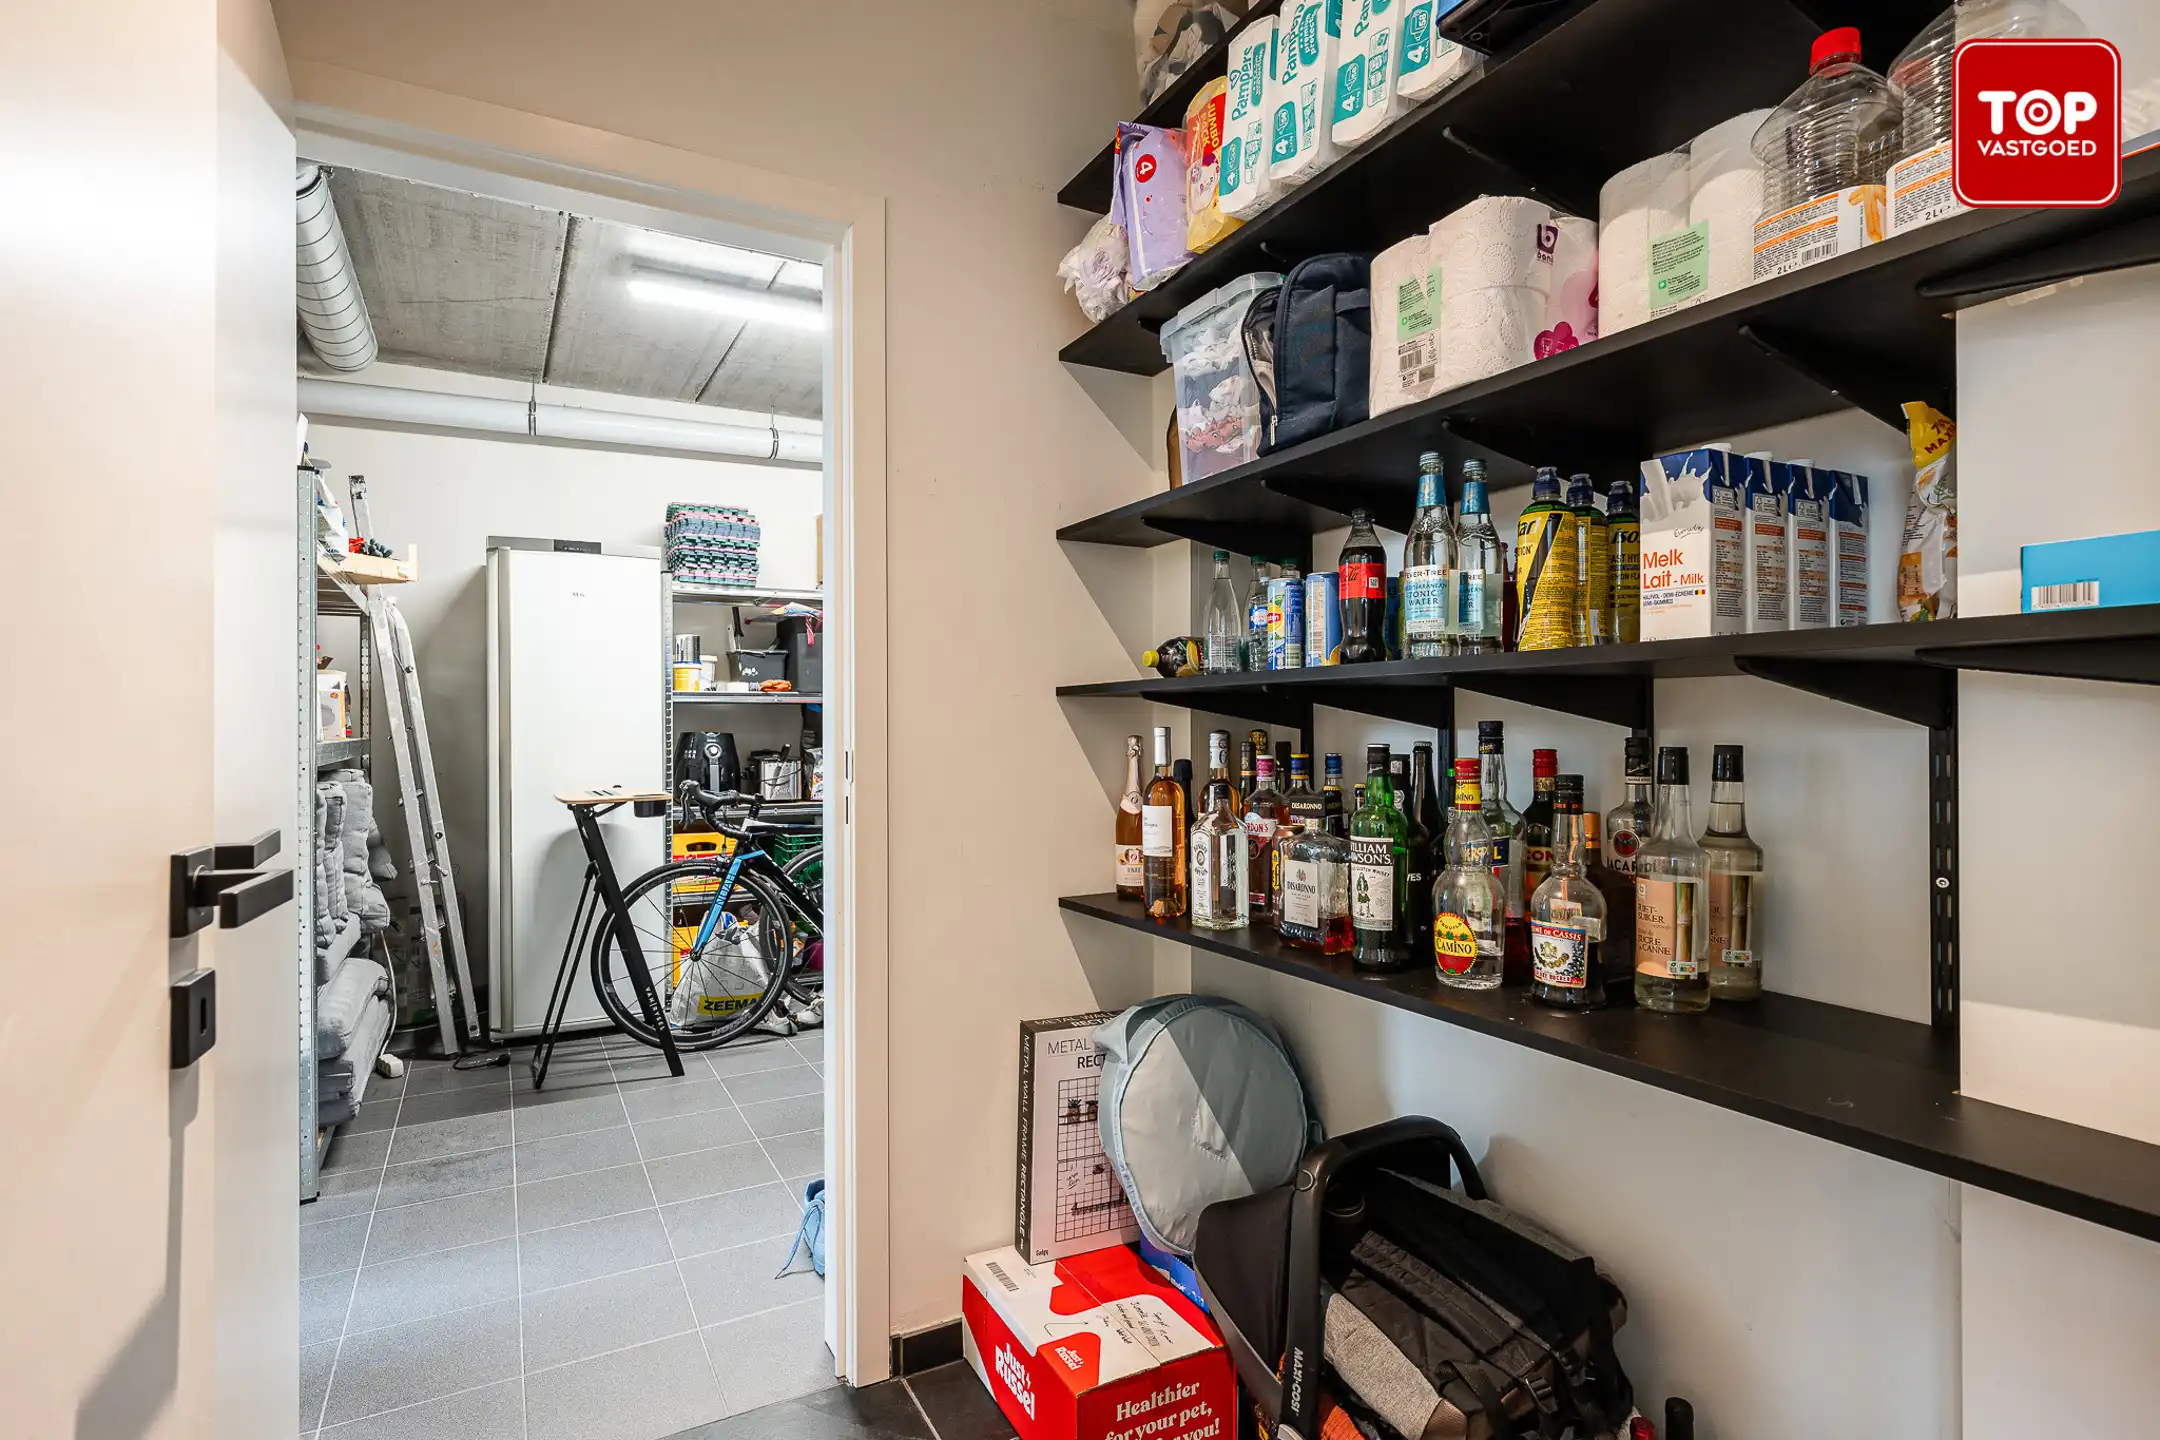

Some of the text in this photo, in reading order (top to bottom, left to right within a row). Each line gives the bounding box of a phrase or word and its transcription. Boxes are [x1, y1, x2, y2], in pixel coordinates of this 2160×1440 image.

[1407, 45, 1424, 63] 4
[1232, 44, 1252, 121] Pampers
[1342, 95, 1355, 111] 4
[1208, 103, 1220, 148] JUMBO
[1276, 139, 1288, 154] 4
[1140, 161, 1153, 175] 4
[1227, 172, 1235, 186] 4
[1643, 549, 1684, 570] Melk
[1643, 570, 1672, 589] Lait
[1680, 573, 1704, 585] Milk
[1409, 590, 1436, 598] TONIC
[1409, 598, 1438, 606] WATER
[1291, 802, 1322, 810] DISARONNO
[1287, 881, 1316, 895] DISARONNO
[1552, 929, 1582, 941] CASSIS
[1022, 1034, 1030, 1075] METAL
[1047, 1037, 1091, 1055] METAL
[1020, 1113, 1029, 1161] FRAME
[1018, 1162, 1028, 1239] RECTANGLE
[1004, 1342, 1025, 1387] Just
[1054, 1346, 1082, 1371] Russel
[995, 1344, 1035, 1421] Russel
[1116, 1382, 1200, 1421] Healthier
[1134, 1413, 1177, 1440] your
[1179, 1401, 1213, 1427] pet,
[1181, 1417, 1220, 1440] you!
